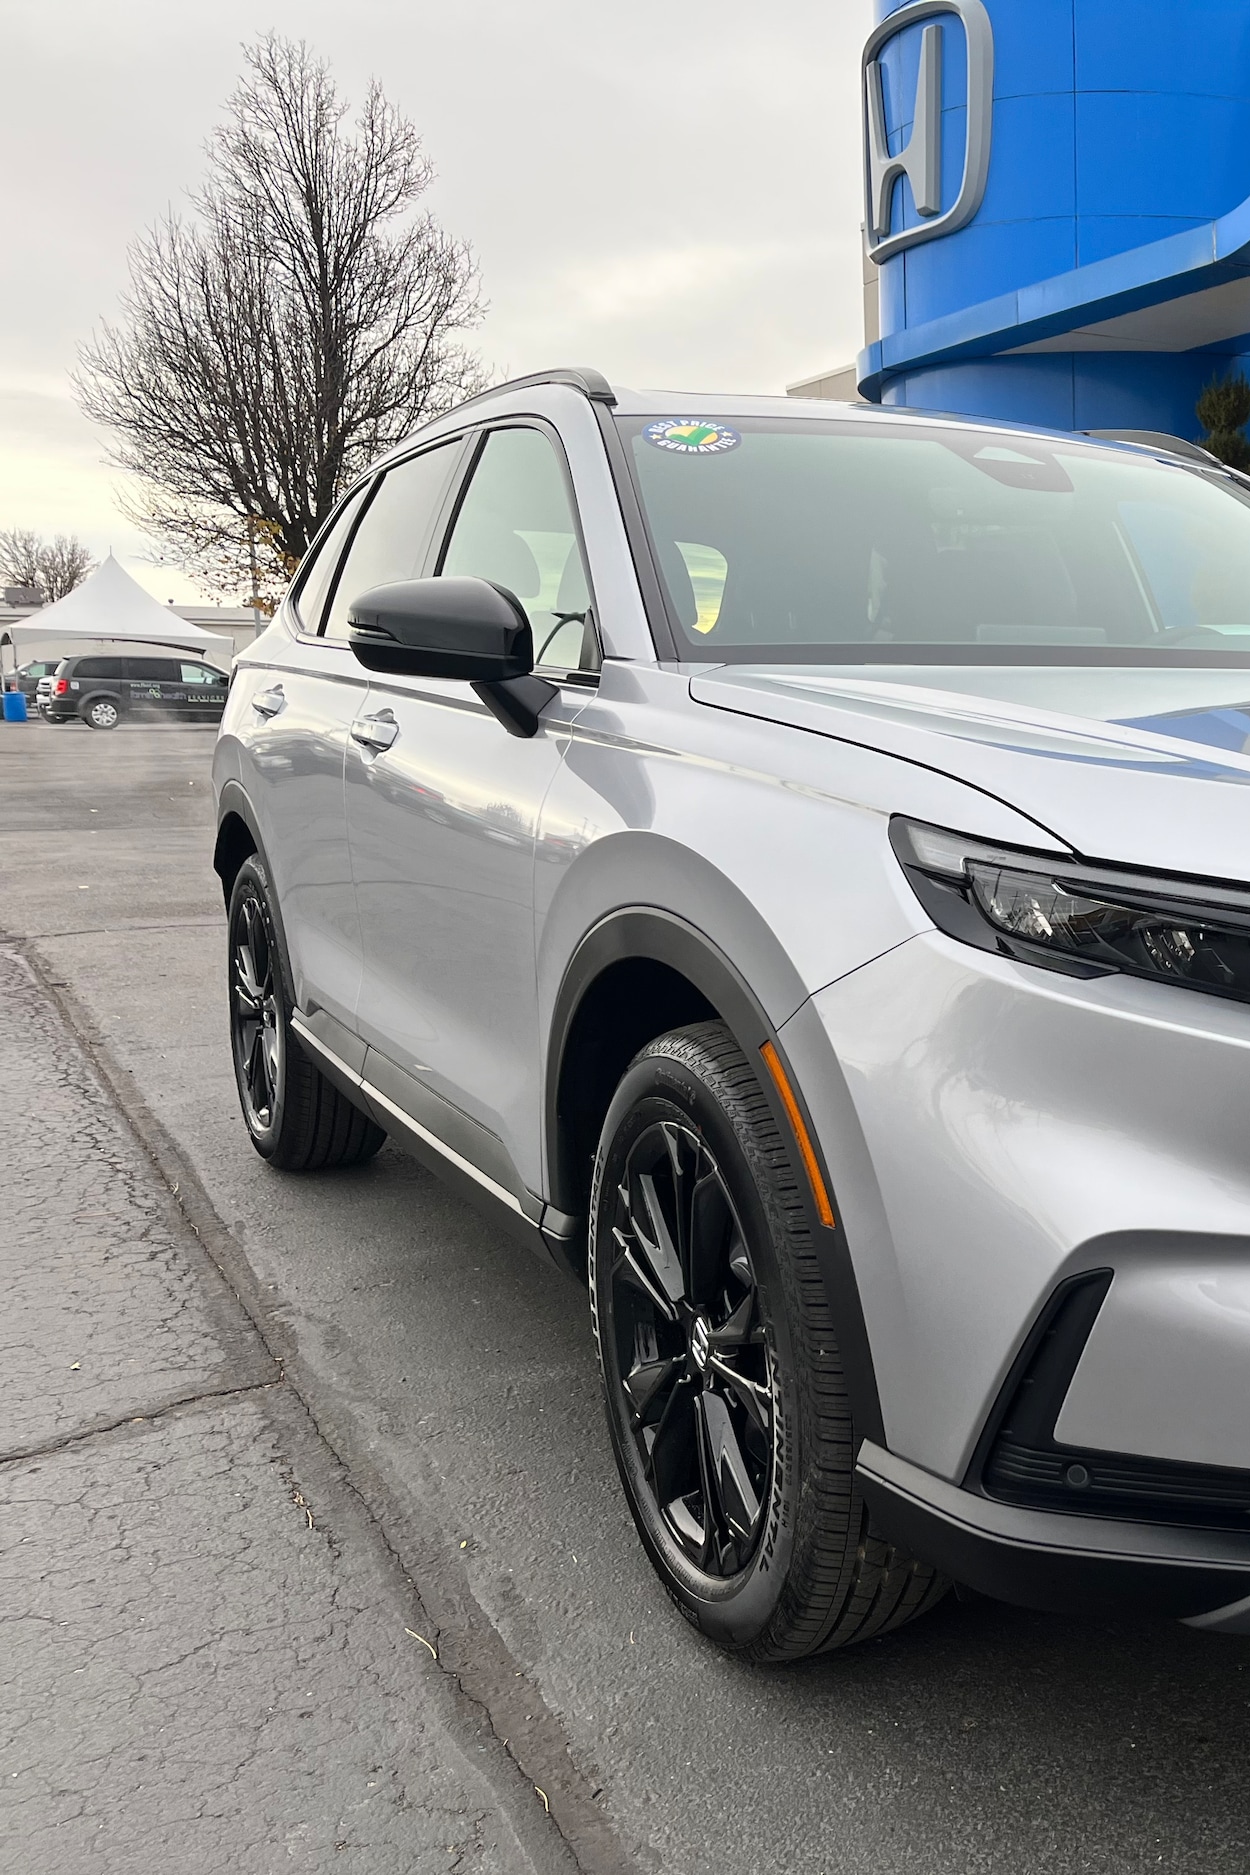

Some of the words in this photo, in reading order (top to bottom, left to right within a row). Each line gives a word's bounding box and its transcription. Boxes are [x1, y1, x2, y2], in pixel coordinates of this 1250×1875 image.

[648, 420, 678, 433] BEST
[680, 419, 725, 431] PRICE
[656, 437, 737, 453] GUARANTEE
